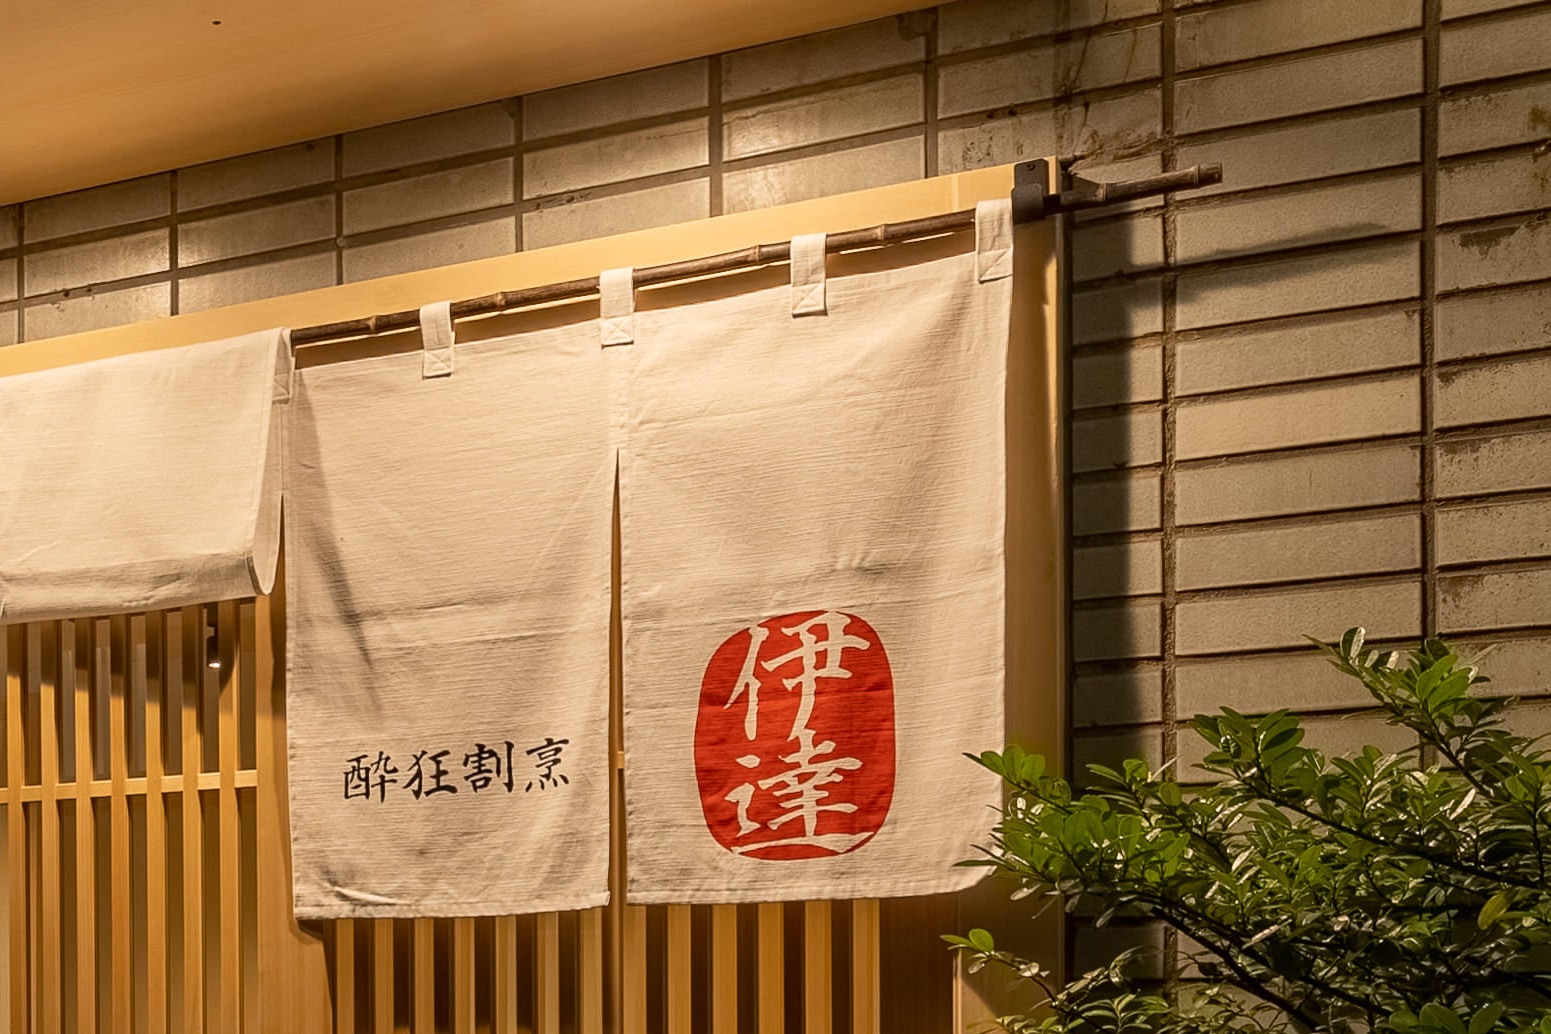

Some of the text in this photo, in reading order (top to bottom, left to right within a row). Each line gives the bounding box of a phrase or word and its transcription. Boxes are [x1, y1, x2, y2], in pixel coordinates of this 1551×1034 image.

[343, 737, 570, 803] 酔狂割烹
[722, 610, 876, 854] 伊達
